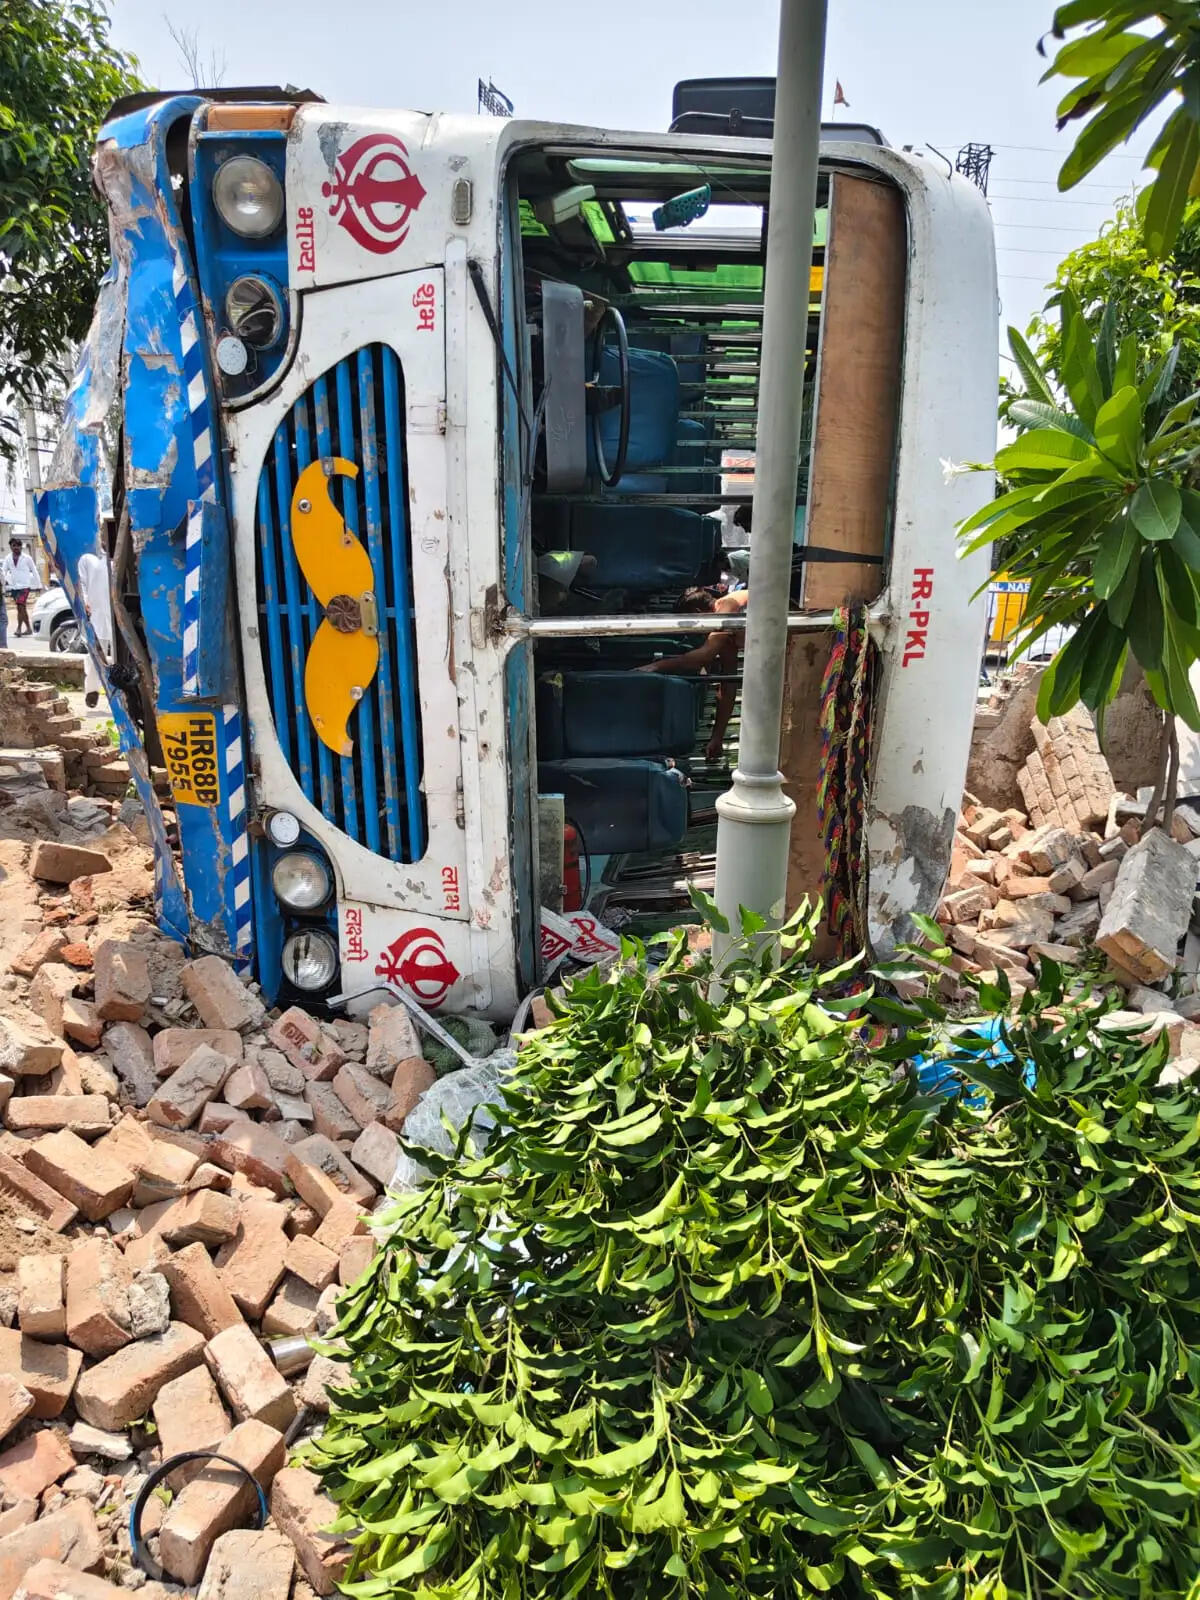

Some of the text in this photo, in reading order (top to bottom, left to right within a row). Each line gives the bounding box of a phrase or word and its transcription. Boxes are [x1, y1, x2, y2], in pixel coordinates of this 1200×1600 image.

[295, 207, 369, 962] भाग्य लक्ष्मी
[412, 284, 460, 911] शुभ लाभ
[902, 567, 934, 668] HR-PKL
[164, 731, 192, 791] 7955
[189, 719, 218, 804] HR68B
